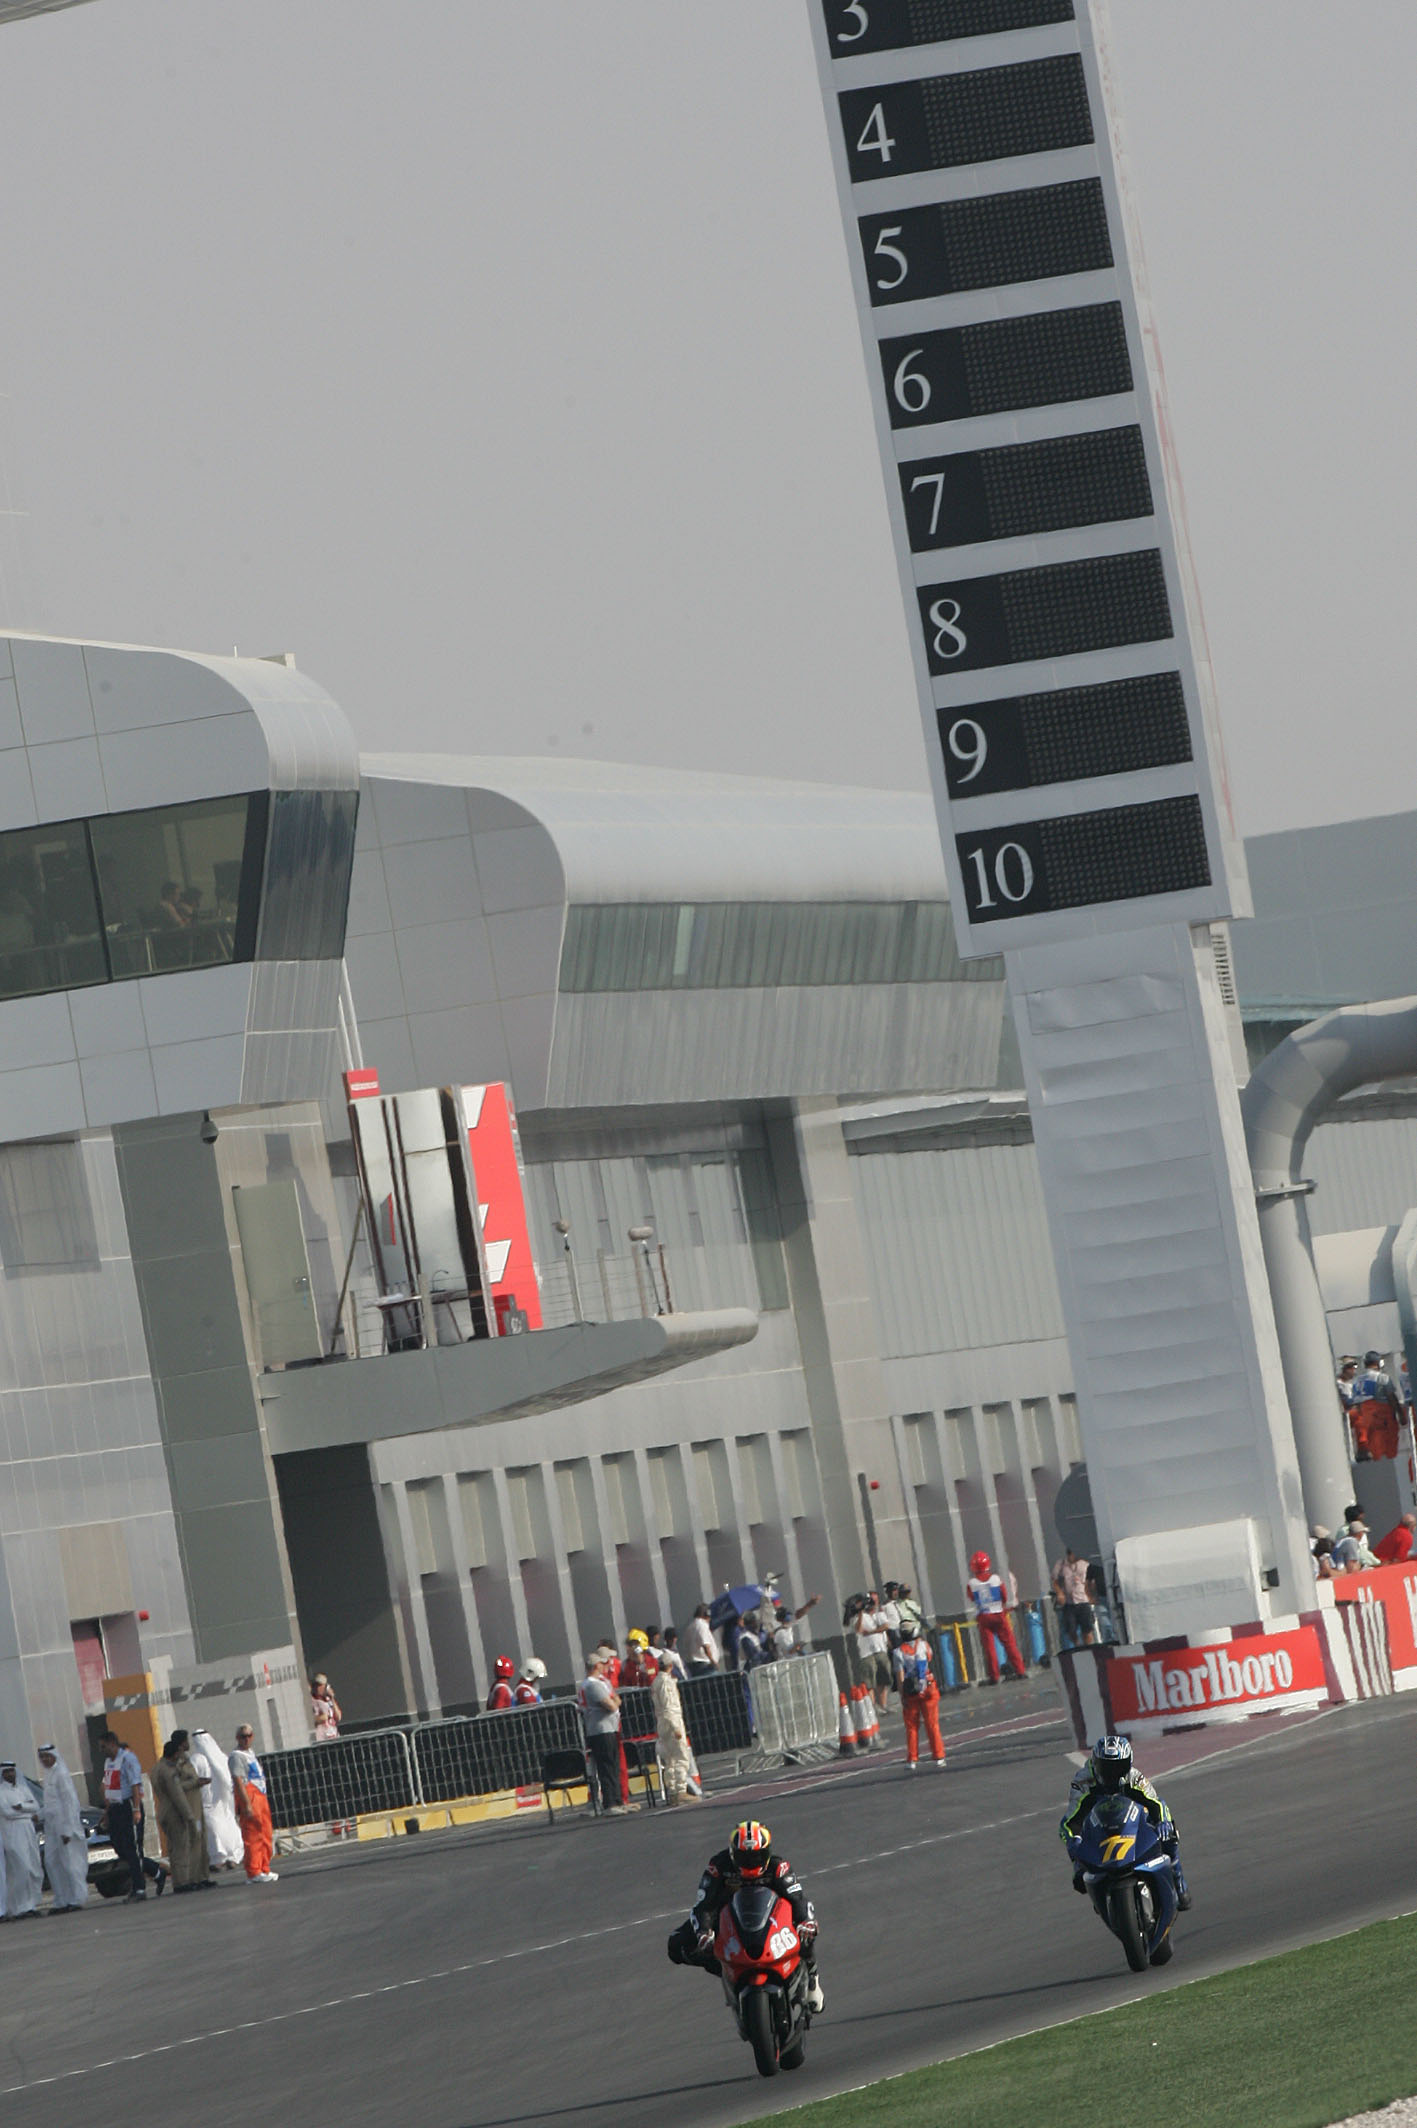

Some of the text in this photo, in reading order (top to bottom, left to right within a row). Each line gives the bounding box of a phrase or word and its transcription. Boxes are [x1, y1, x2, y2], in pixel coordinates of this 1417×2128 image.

[838, 0, 868, 42] 3
[856, 102, 895, 162] 4
[874, 226, 908, 290] 5
[893, 349, 931, 412] 6
[910, 472, 945, 535] 7
[929, 599, 967, 658] 8
[948, 719, 988, 784] 9
[967, 843, 1034, 909] 10
[1131, 1649, 1293, 1713] Marlboro
[1100, 1835, 1136, 1864] 77
